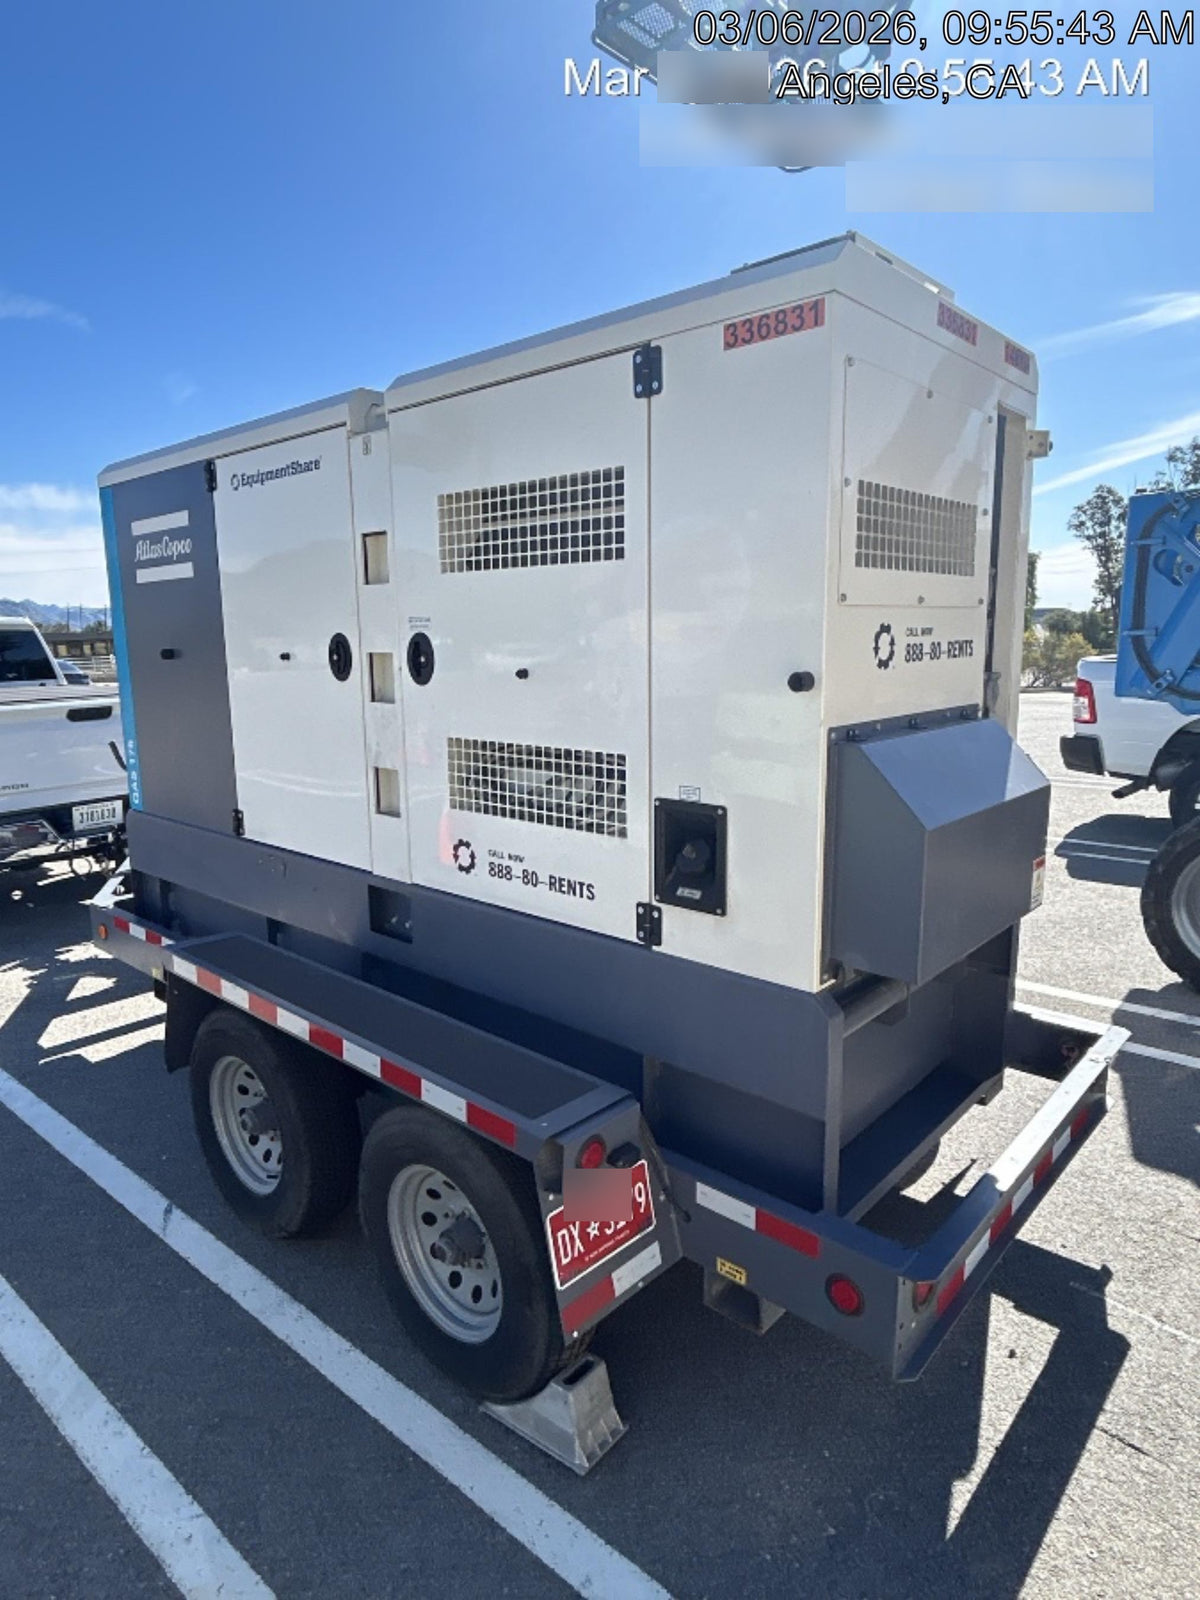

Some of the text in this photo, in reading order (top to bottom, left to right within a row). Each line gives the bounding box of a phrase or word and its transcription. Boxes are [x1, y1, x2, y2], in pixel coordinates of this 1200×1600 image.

[725, 300, 822, 349] 336831
[241, 457, 321, 488] EquipmentShare
[134, 535, 192, 562] Atlas Copco
[904, 639, 974, 663] 888-80-RENTS
[488, 849, 525, 863] CALL NOW
[488, 861, 596, 901] 888-80-RENTS
[556, 1221, 586, 1265] DX
